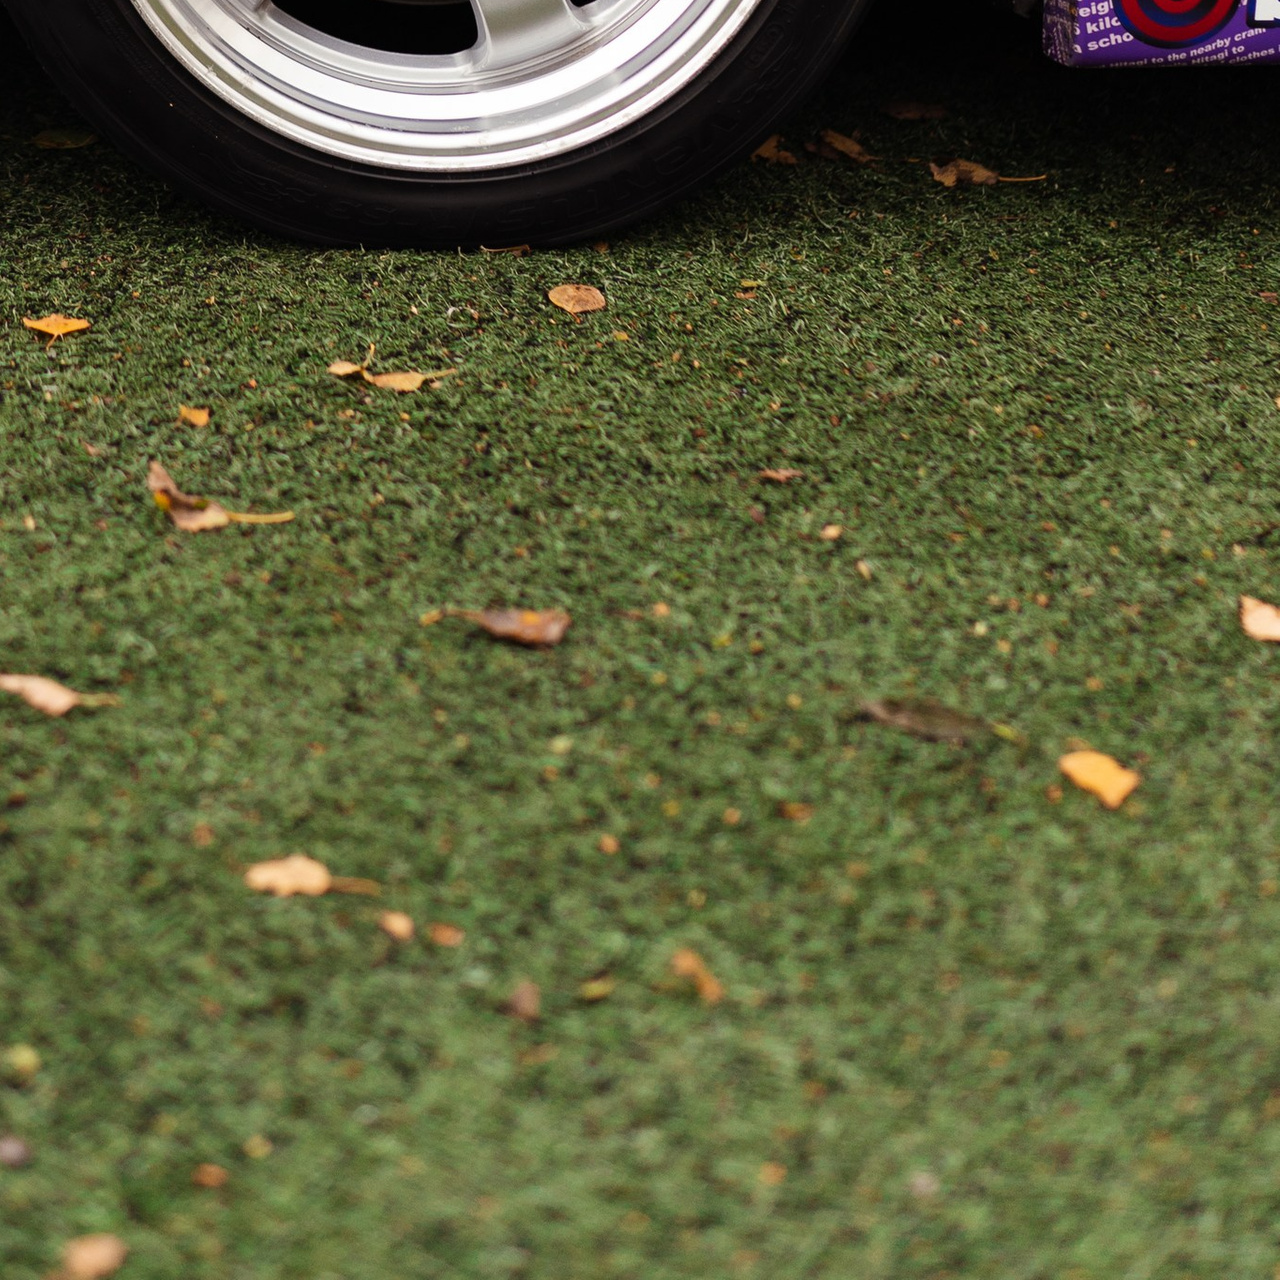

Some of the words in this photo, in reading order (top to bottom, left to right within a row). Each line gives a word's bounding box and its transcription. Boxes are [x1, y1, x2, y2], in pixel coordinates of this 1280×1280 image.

[1087, 31, 1134, 51] scho
[1167, 49, 1188, 63] the
[1189, 36, 1232, 58] nearby
[1231, 45, 1246, 56] to
